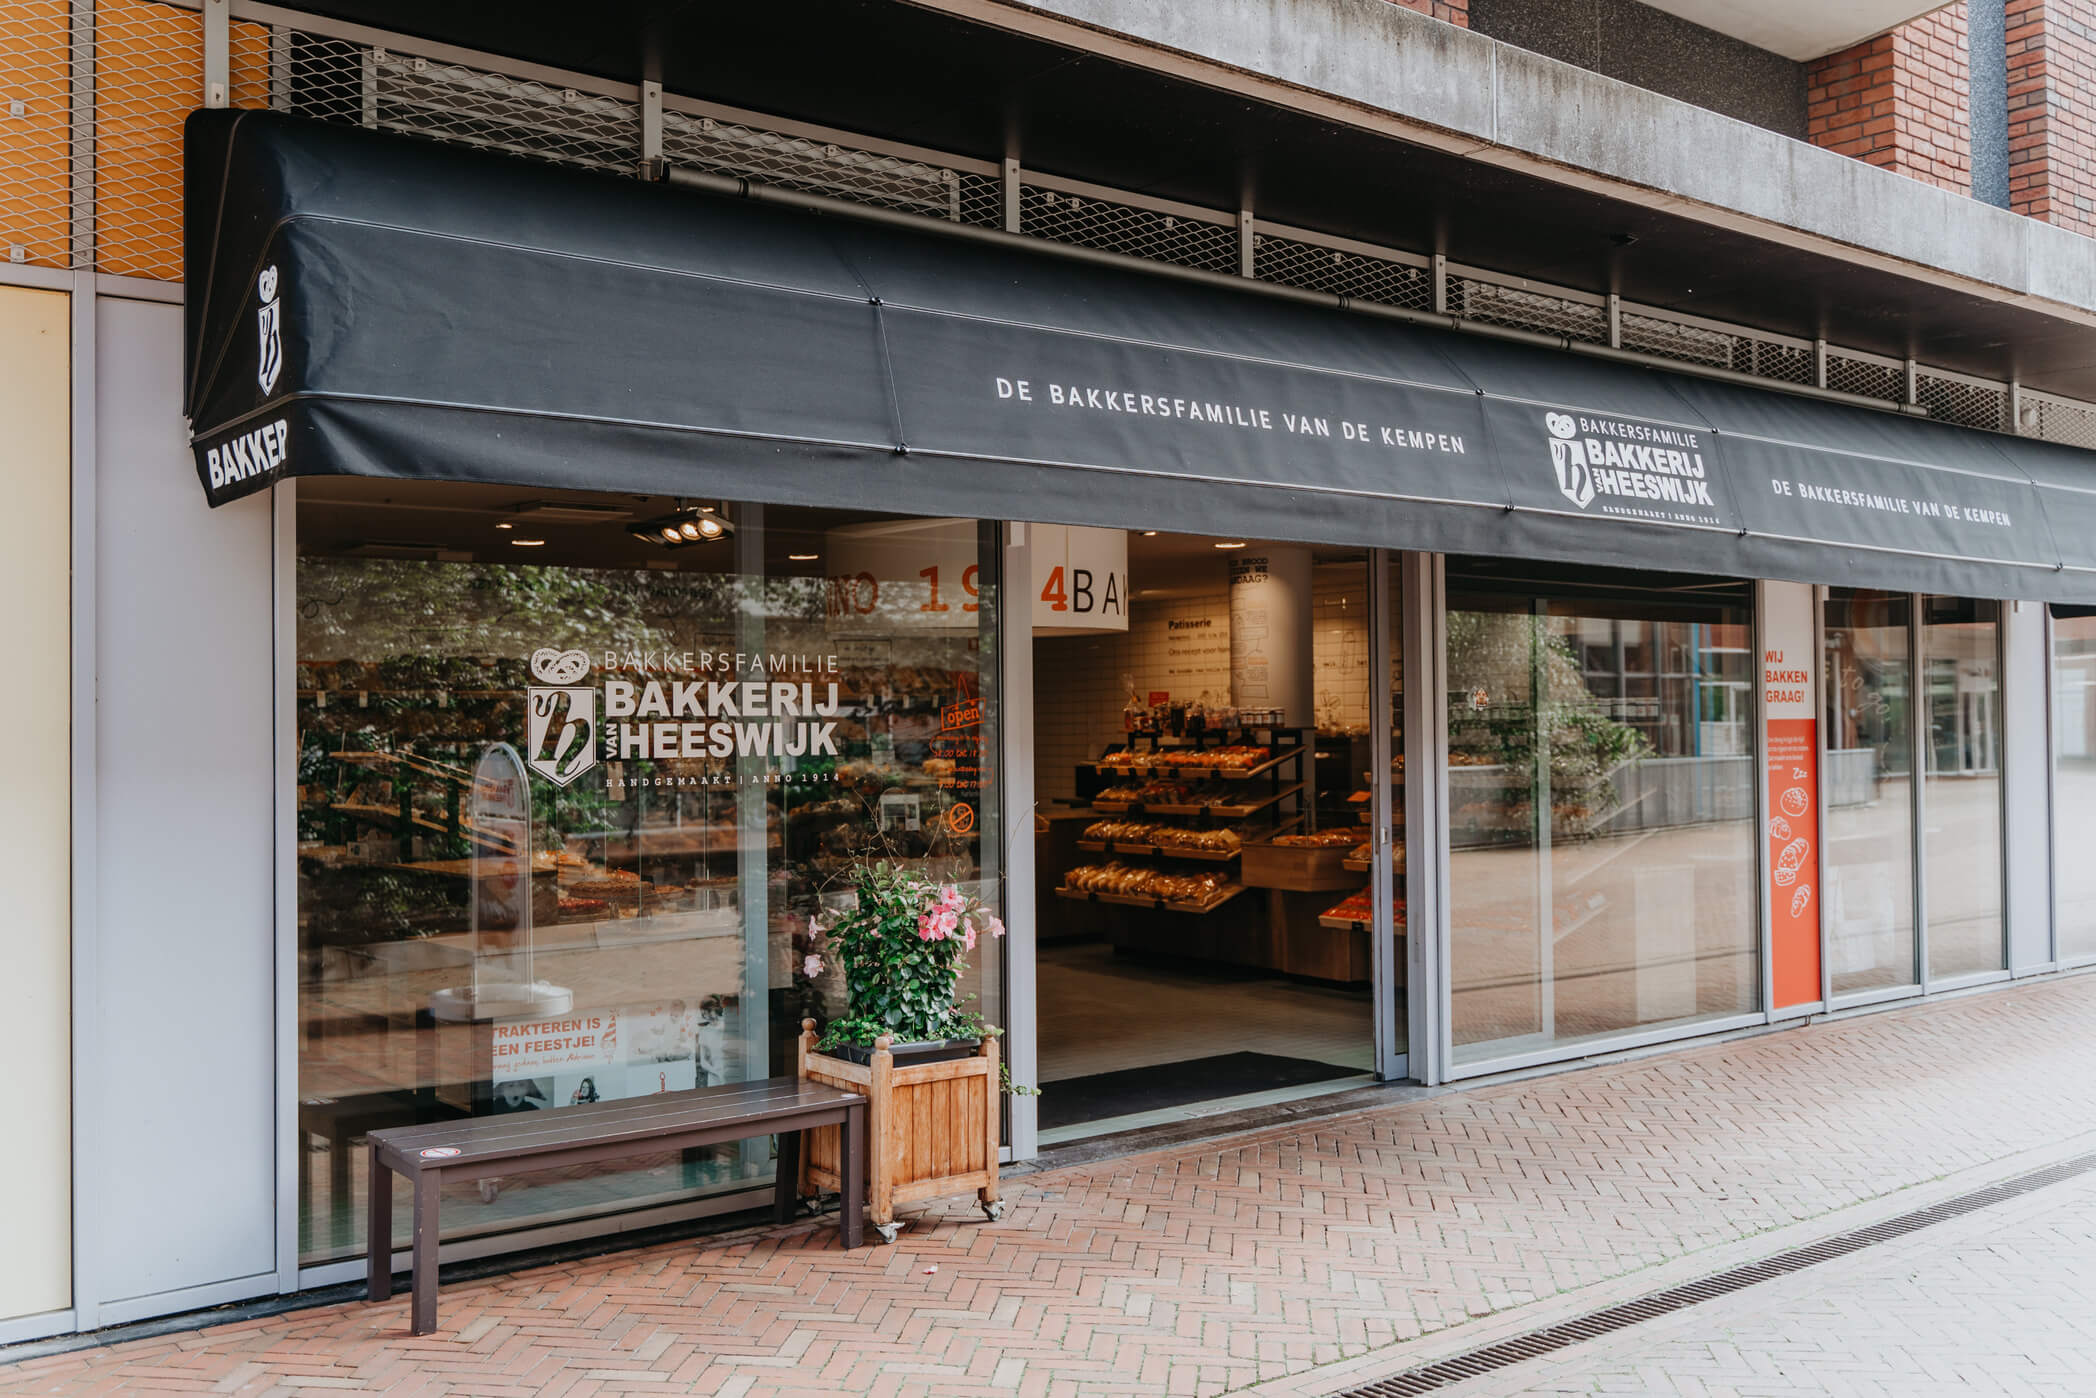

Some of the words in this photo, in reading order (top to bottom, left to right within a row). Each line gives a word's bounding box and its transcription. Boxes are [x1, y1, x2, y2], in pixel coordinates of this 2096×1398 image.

[996, 377, 1033, 401] DE
[1049, 384, 1273, 430] BAKKERSFAMILIE
[1283, 413, 1330, 437] VAN
[1342, 421, 1371, 442] DE
[1381, 426, 1465, 454] KEMPEN
[1580, 417, 1699, 449] BAKKERSFAMILIE
[1584, 438, 1705, 479] BAKKERIJ
[1592, 468, 1604, 493] VAN
[1600, 471, 1715, 506] HEESWIJK
[1771, 479, 1793, 496] DE
[1798, 483, 1910, 514] BAKKERSFAMILIE
[1912, 501, 1941, 517] VAN
[1944, 504, 1961, 520] DE
[1964, 508, 2012, 527] KEMPEN
[1168, 618, 1212, 630] Patisserie
[604, 650, 839, 673] BAKKERSFAMILIE
[1765, 649, 1783, 664] WIJ
[1765, 670, 1808, 684] BAKKEN
[604, 680, 839, 718] BAKKERIJ
[1765, 689, 1806, 704] GRAAG!
[947, 705, 980, 726] open
[605, 723, 618, 760] VAN
[619, 721, 839, 760] HEESWIJK
[605, 774, 732, 788] HANDGEMAAKT
[751, 774, 793, 785] ANNO
[801, 771, 840, 783] 1914
[492, 1019, 582, 1040] TRAKTEREN
[586, 1017, 601, 1030] IS
[492, 1044, 519, 1058] EEN
[524, 1035, 595, 1054] FEESTJE!
